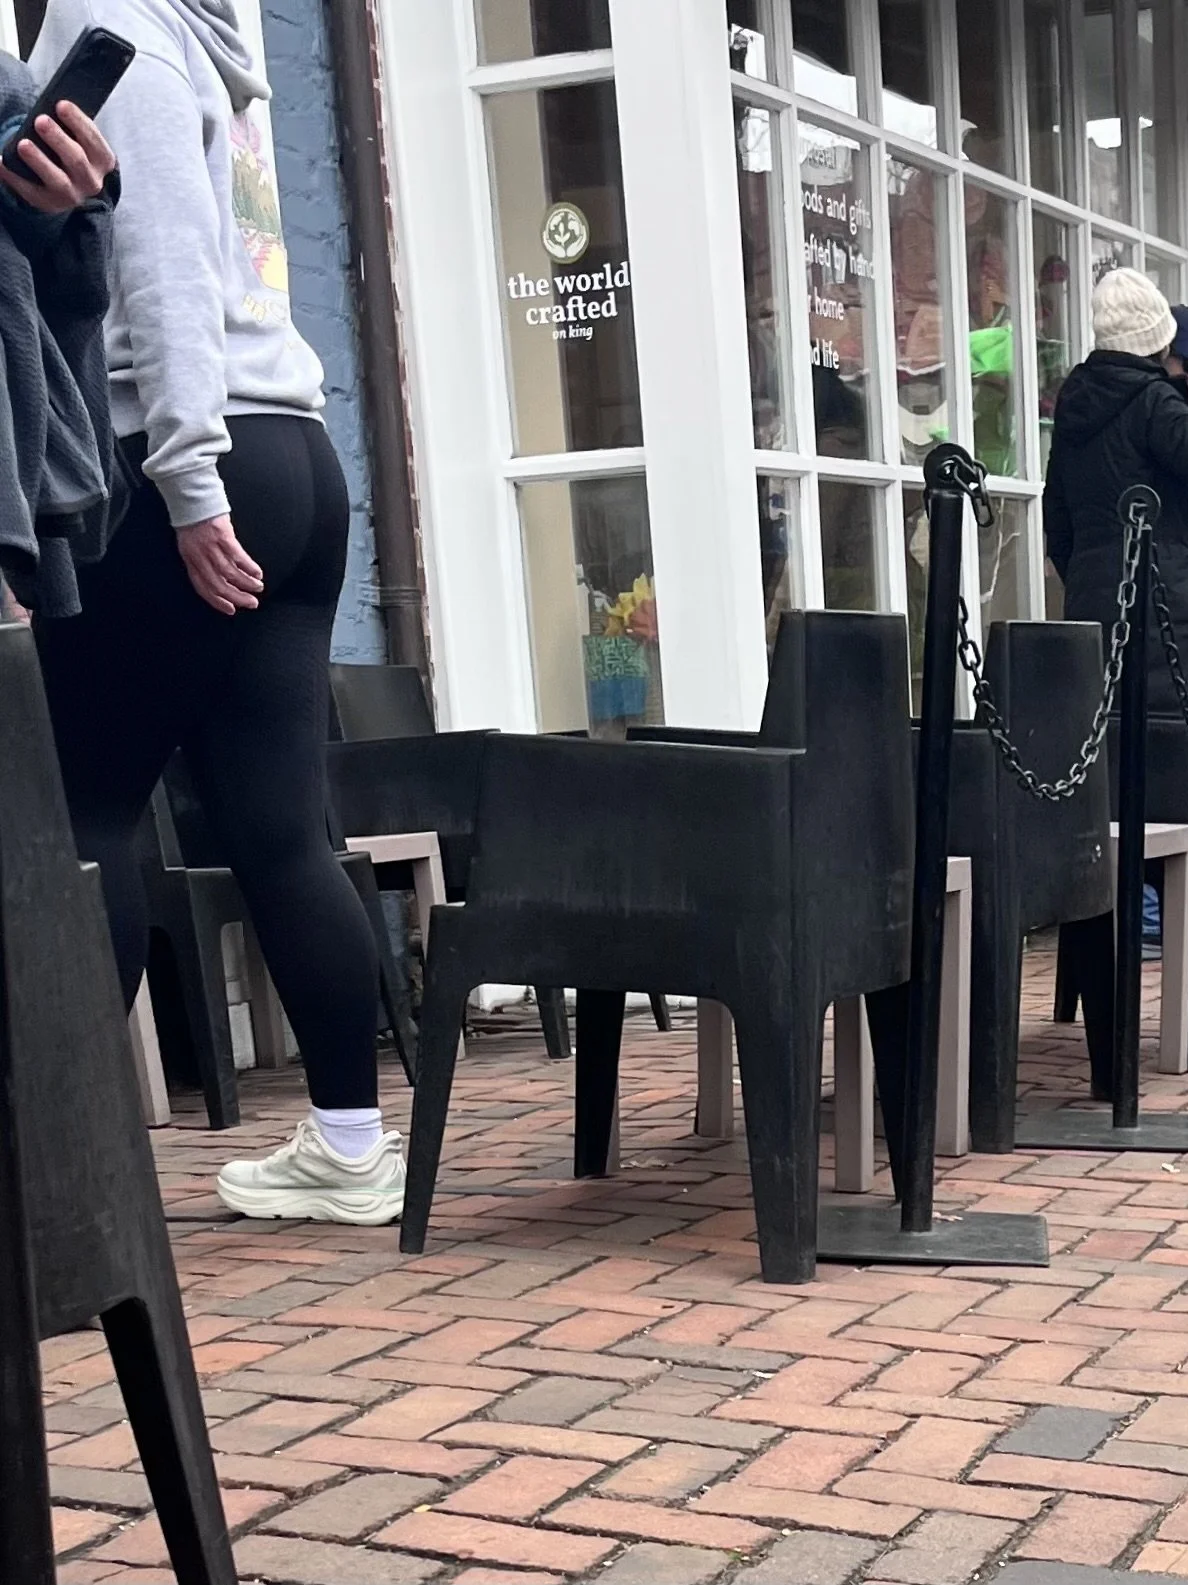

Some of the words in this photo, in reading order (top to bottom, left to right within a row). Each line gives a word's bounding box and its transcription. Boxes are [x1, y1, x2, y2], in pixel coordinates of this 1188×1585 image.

[826, 193, 847, 222] and
[508, 272, 550, 299] the
[553, 260, 631, 295] world
[525, 291, 618, 326] crafted
[814, 286, 845, 320] home
[552, 329, 567, 341] on
[568, 324, 593, 340] king
[822, 338, 840, 369] life
